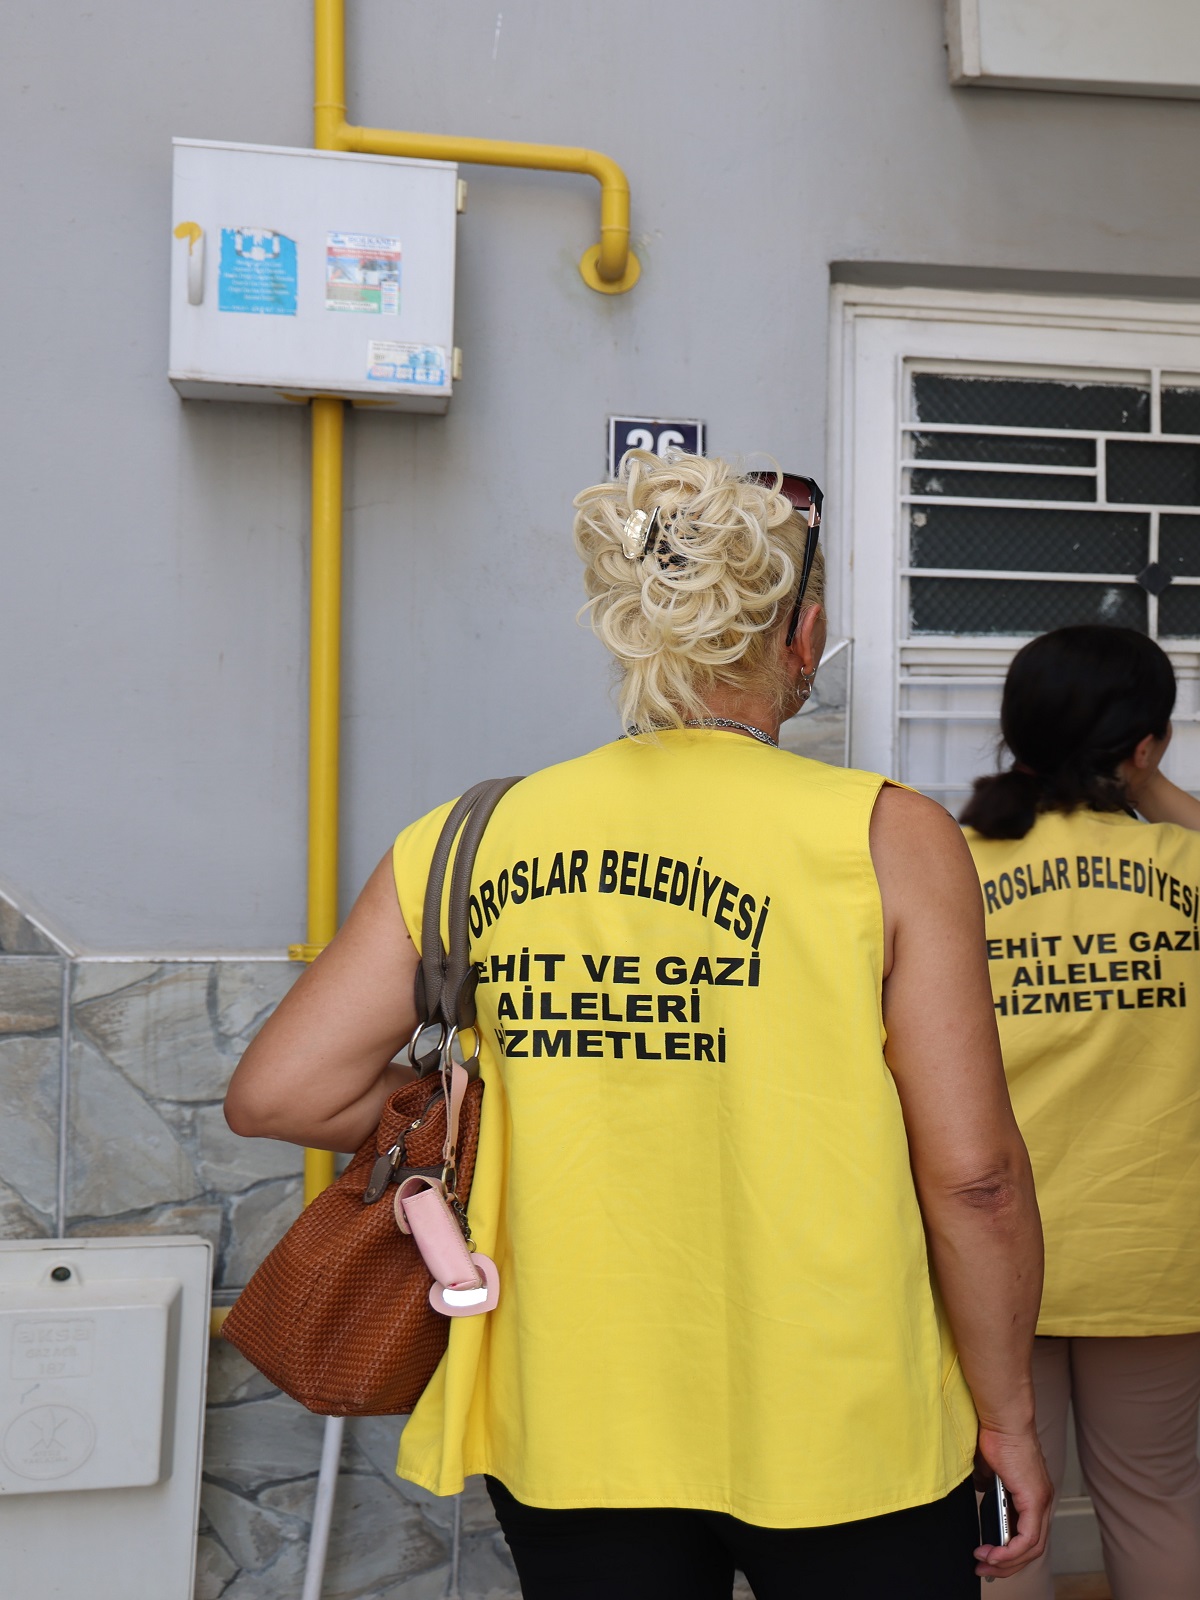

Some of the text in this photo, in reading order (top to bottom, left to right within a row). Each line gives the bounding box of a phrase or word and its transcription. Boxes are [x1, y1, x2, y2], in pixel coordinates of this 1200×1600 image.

[469, 849, 772, 951] OROSLAR BELEDİYESİ
[983, 855, 1200, 924] ROSLAR BELEDİYESİ
[986, 925, 1200, 960] EHİT VE GAZİ
[475, 946, 762, 987] EHİT VE GAZİ
[1011, 954, 1163, 988] AİLELERİ
[497, 985, 701, 1023] AİLELERİ
[993, 982, 1187, 1017] HİZMETLERİ
[39, 1362, 66, 1376] 187
